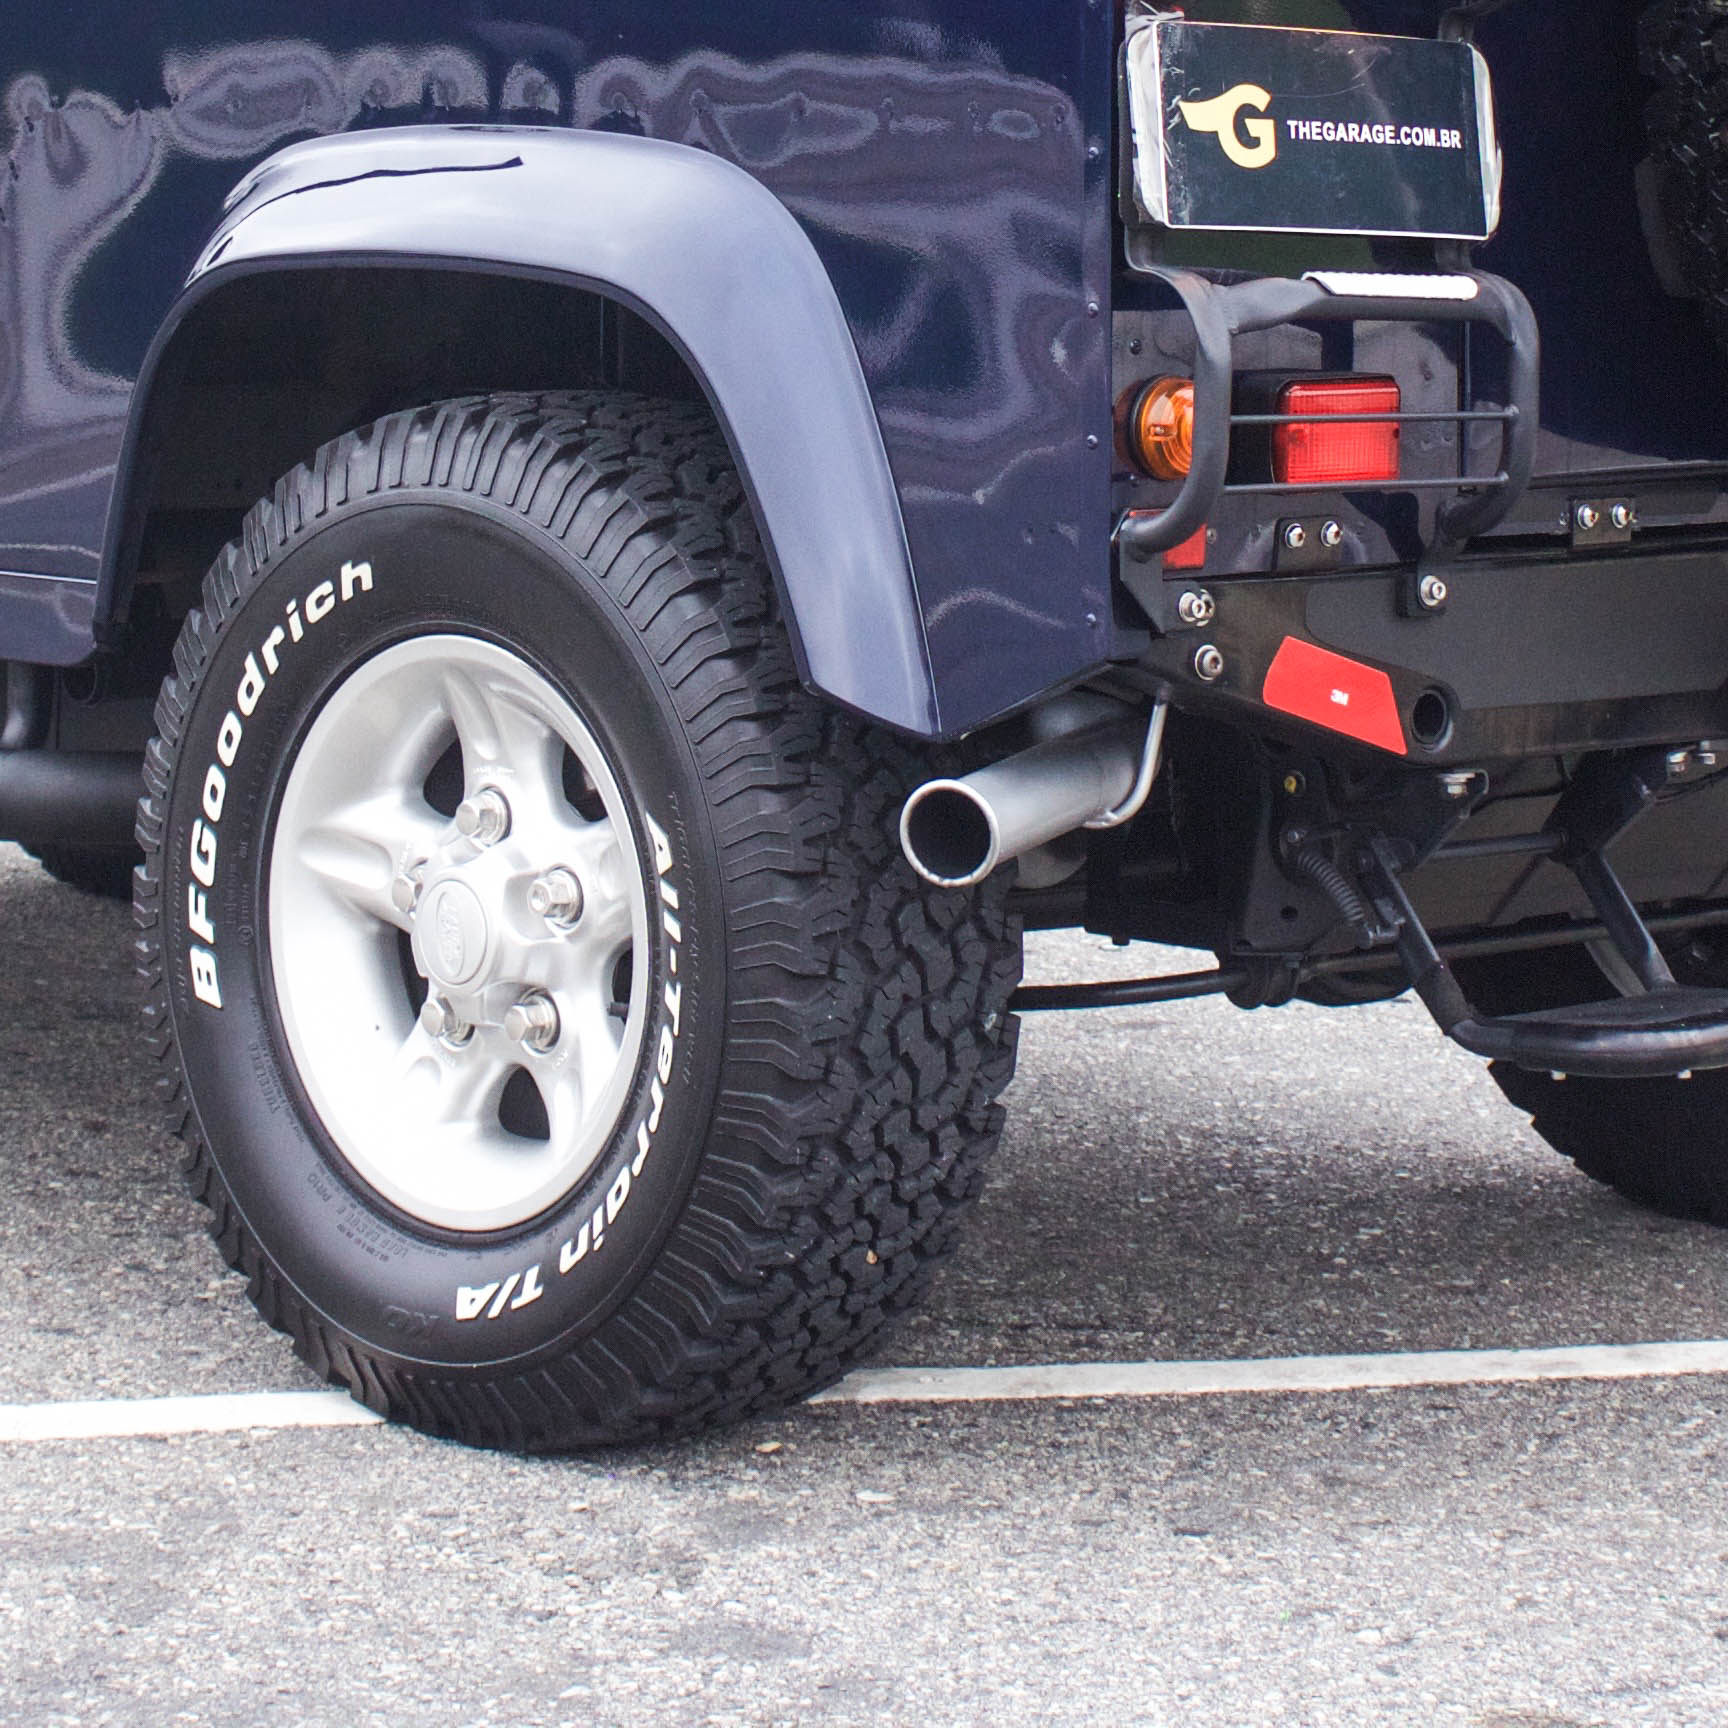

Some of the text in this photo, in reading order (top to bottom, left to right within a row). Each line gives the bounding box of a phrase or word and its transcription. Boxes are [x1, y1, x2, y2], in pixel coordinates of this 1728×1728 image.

[1286, 119, 1462, 149] THEGARAGE.COM.BR
[188, 558, 375, 1009] BFGoodrich
[1330, 688, 1349, 706] 3M
[455, 811, 682, 1321] All-Terrain T/A
